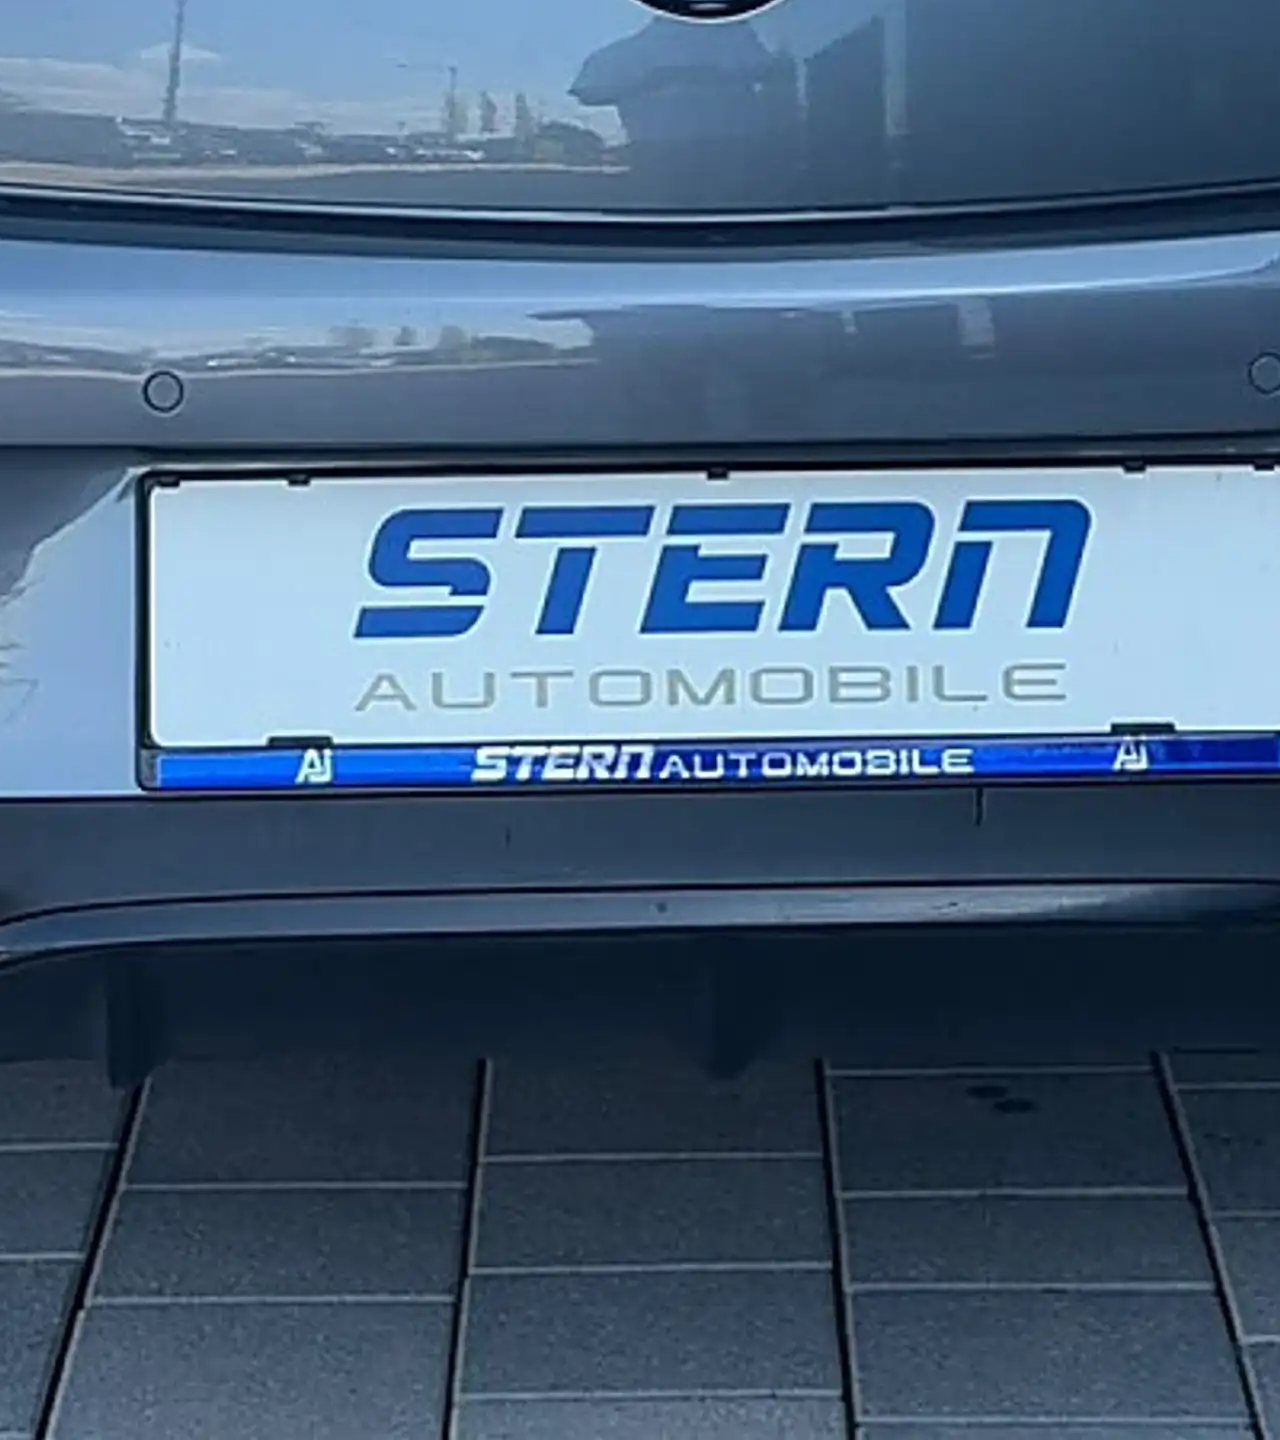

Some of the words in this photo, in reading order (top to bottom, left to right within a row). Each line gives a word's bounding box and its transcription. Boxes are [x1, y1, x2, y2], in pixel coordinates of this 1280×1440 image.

[353, 498, 1093, 639] STERN
[353, 662, 1068, 712] AUTOMOBILE
[470, 744, 655, 782] STERN
[658, 747, 976, 780] AUTOMOBILE
